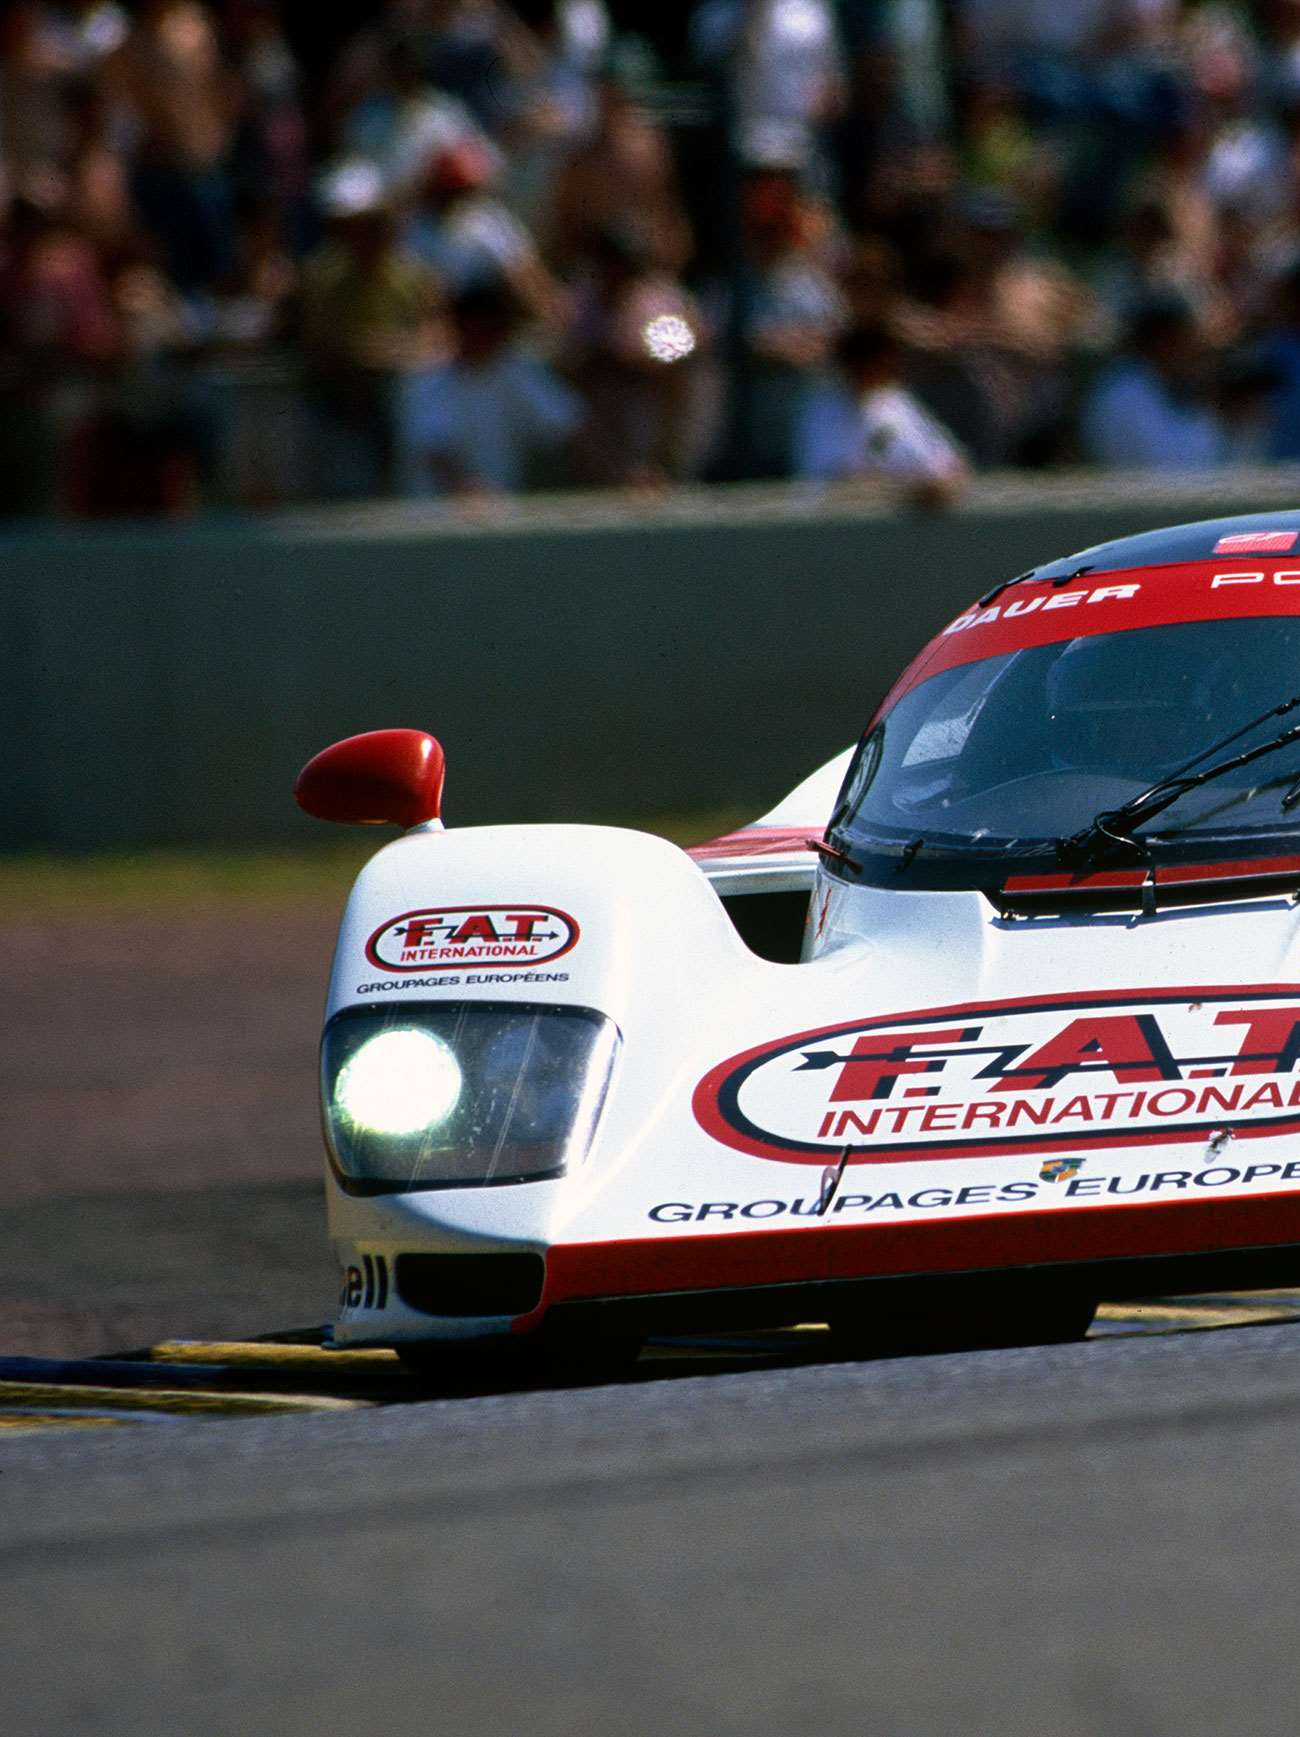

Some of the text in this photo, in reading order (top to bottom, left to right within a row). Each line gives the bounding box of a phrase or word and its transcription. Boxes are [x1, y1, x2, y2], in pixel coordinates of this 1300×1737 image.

[943, 584, 1141, 636] DAUER
[400, 945, 539, 962] INTERNATIONAL
[356, 970, 569, 994] GROUPAGES EUROPÉENS
[648, 1181, 1041, 1223] GROUPAGES
[340, 1253, 389, 1310] ell
